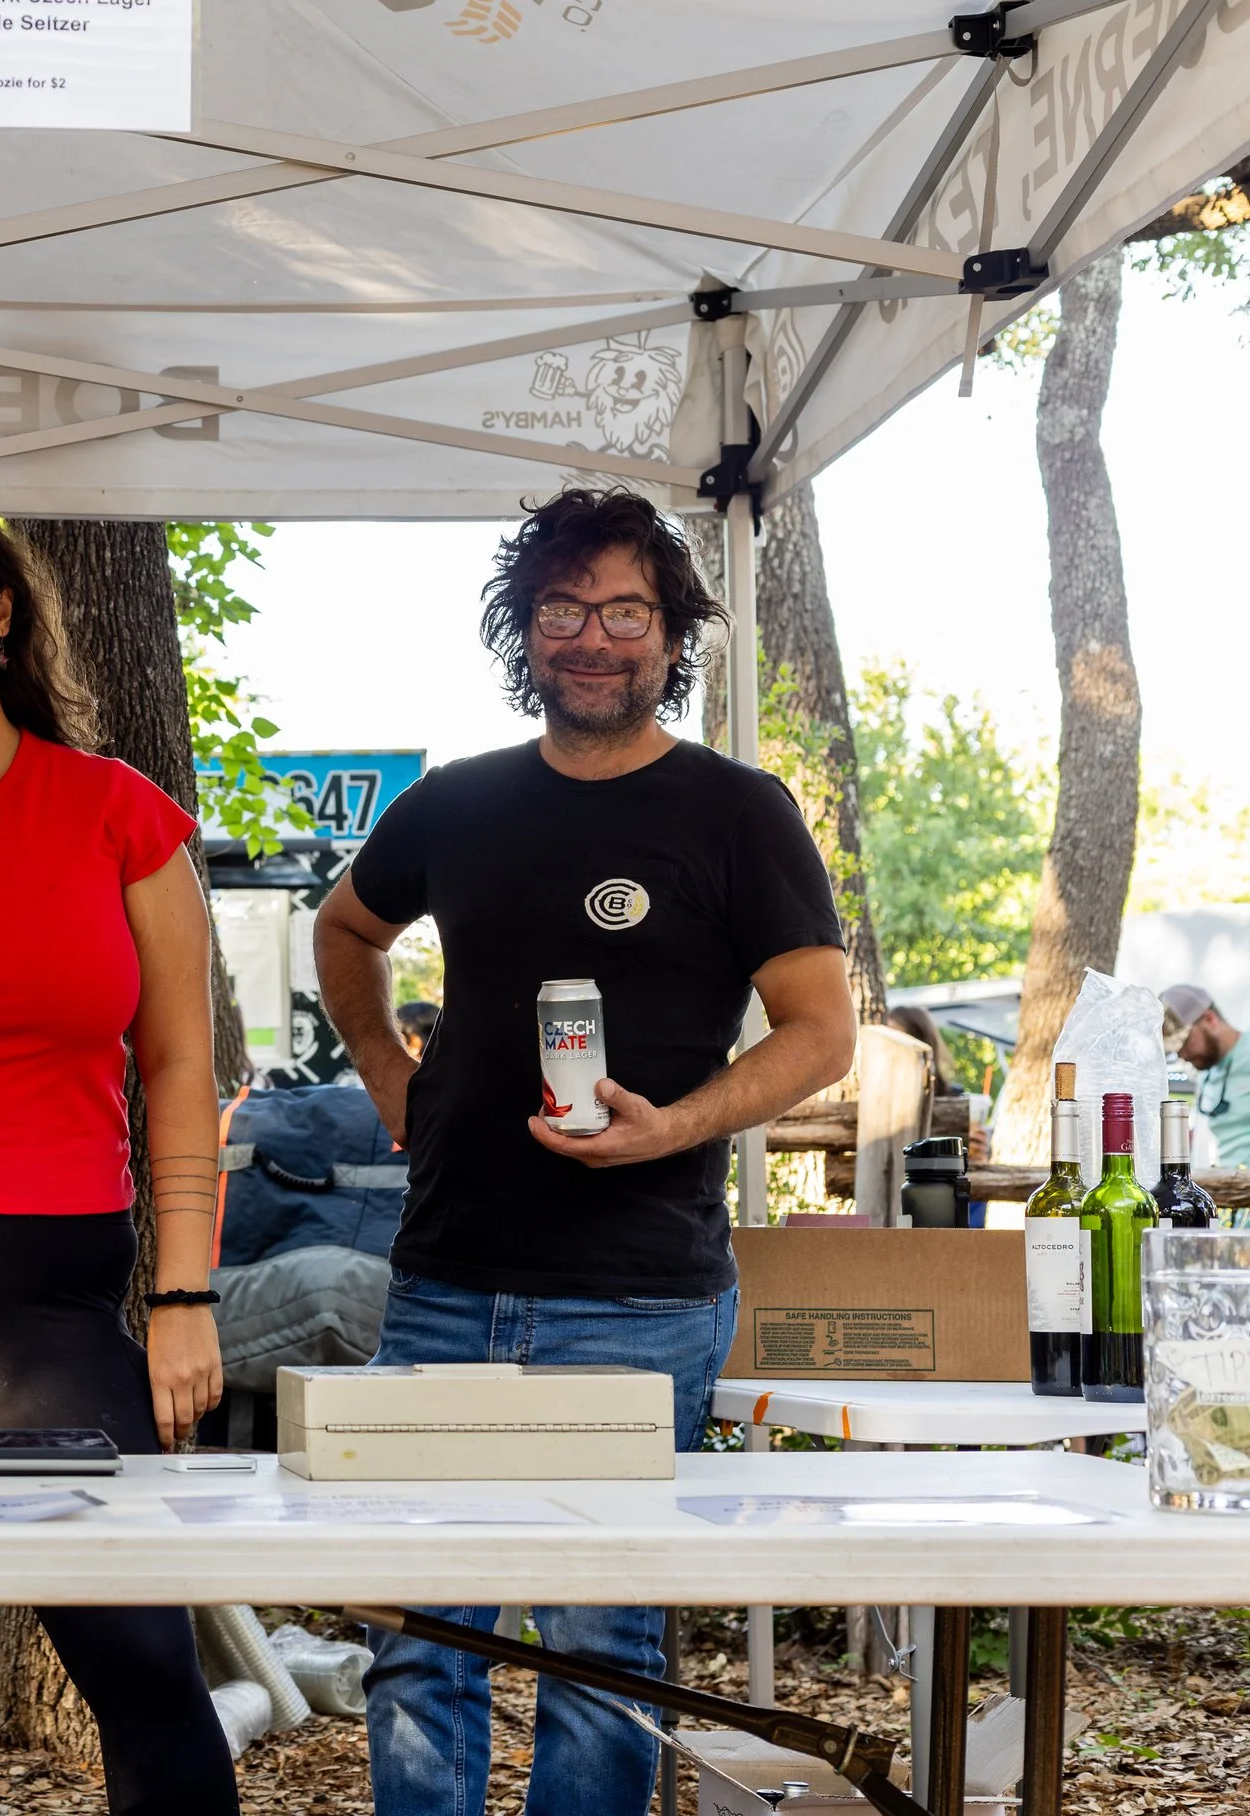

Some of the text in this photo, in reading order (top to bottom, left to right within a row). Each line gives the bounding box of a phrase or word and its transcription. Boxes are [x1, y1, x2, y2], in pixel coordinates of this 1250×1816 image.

[20, 14, 91, 32] Seltzer
[27, 76, 47, 89] for
[50, 76, 67, 90] $2
[544, 1019, 596, 1036] CZECH
[545, 1034, 587, 1051] MATE
[545, 1050, 598, 1061] DARK LAGER
[785, 1312, 912, 1321] SAFE HANDLING INSTRUCTIONS
